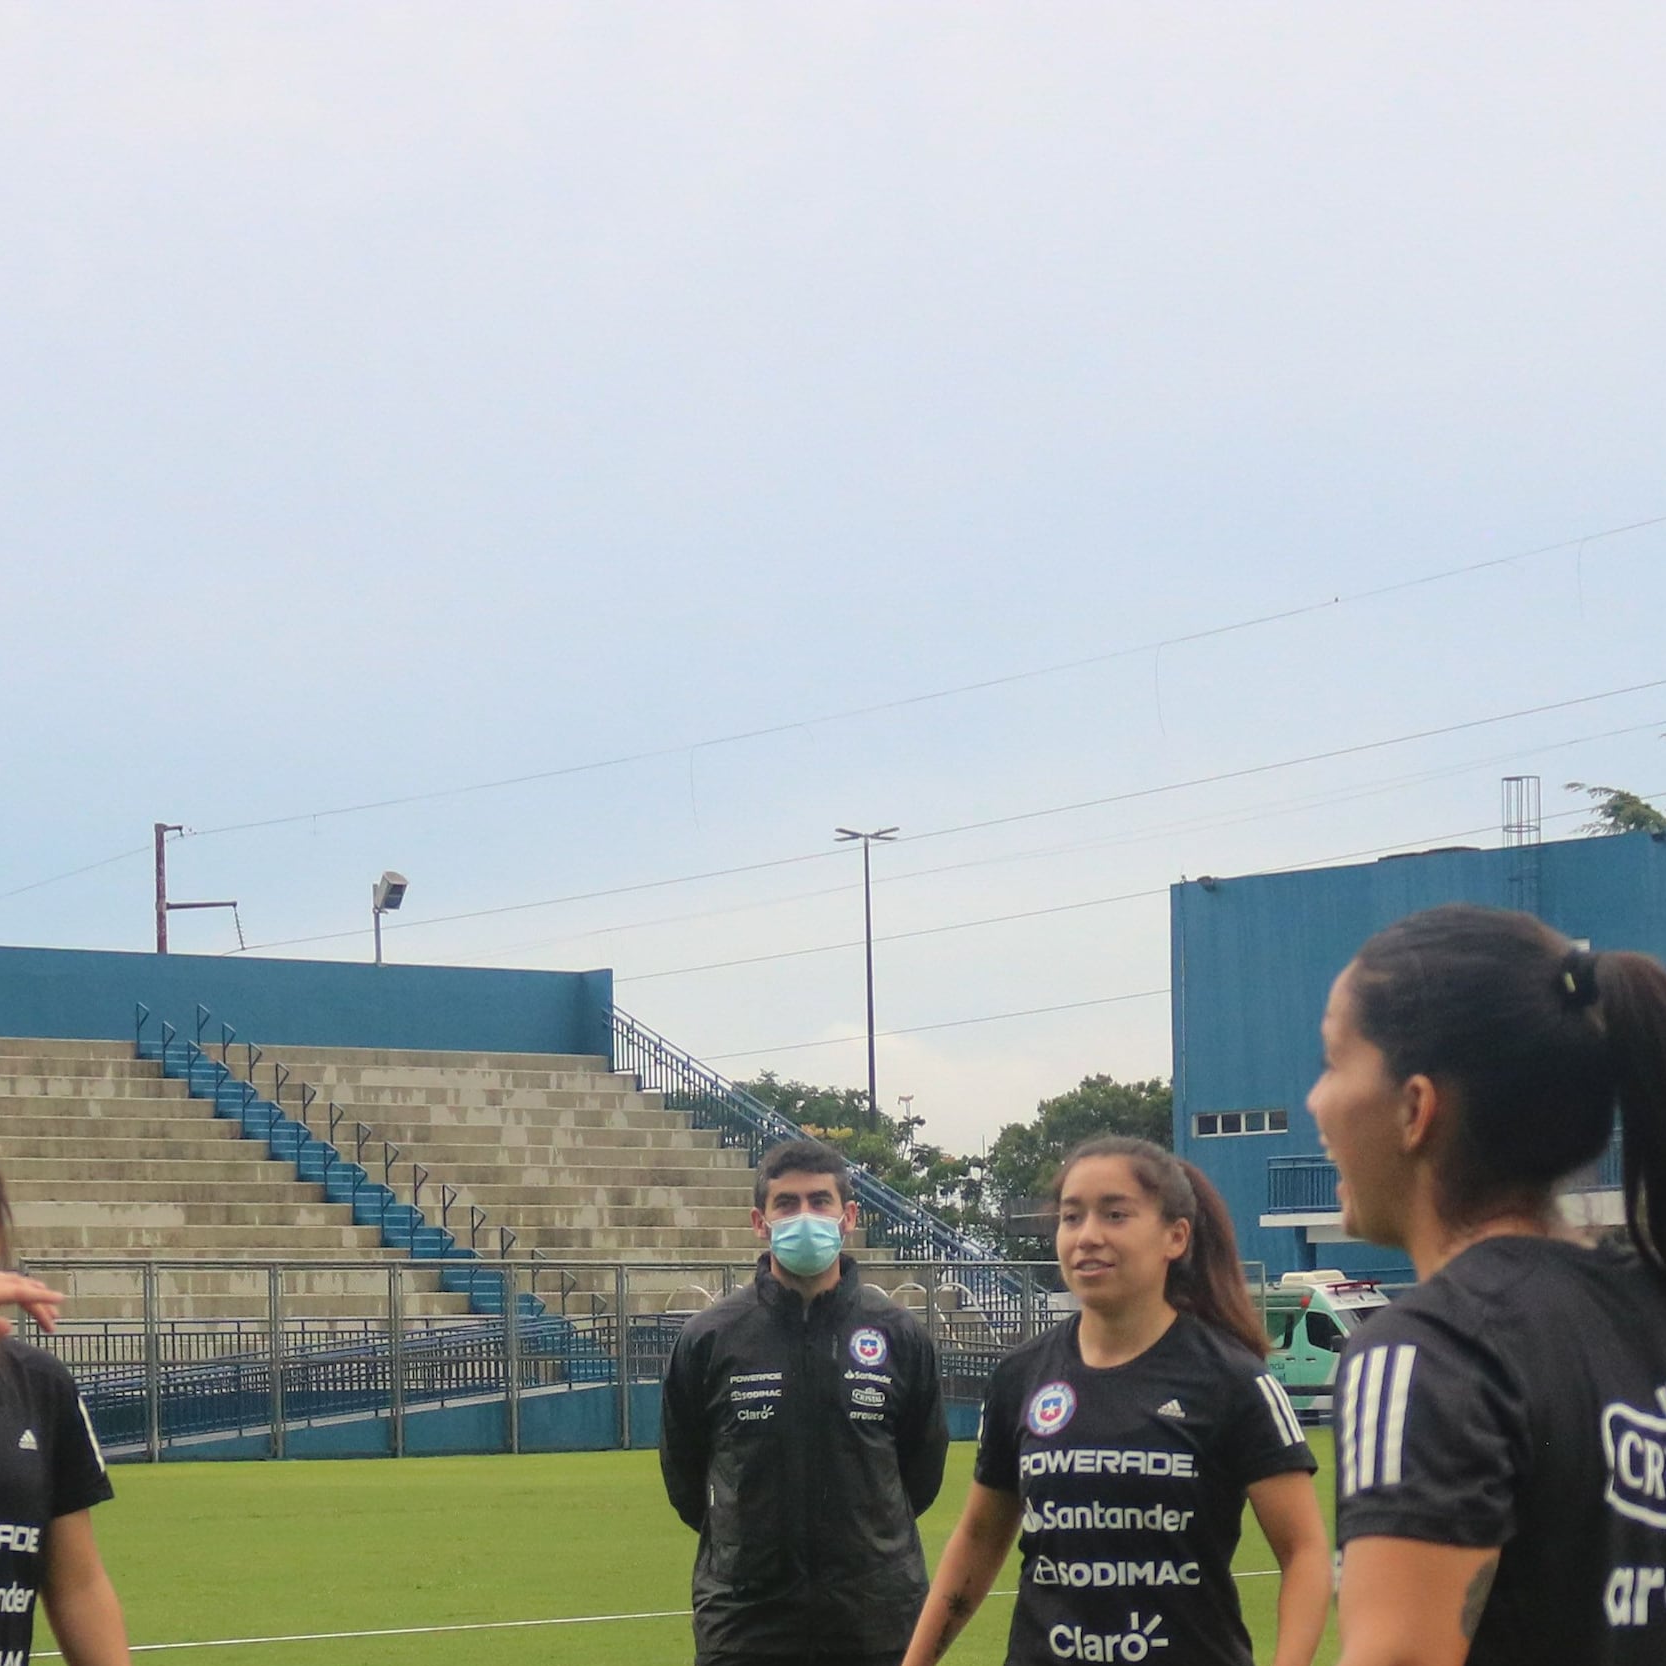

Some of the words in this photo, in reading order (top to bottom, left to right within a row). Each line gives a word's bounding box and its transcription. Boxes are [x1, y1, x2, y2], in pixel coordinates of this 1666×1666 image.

[854, 1371, 892, 1384] Santander
[737, 1409, 769, 1421] Claro
[1043, 1500, 1194, 1532] Santander
[1057, 1560, 1201, 1587] SODIMAC
[1049, 1623, 1148, 1662] Claro
